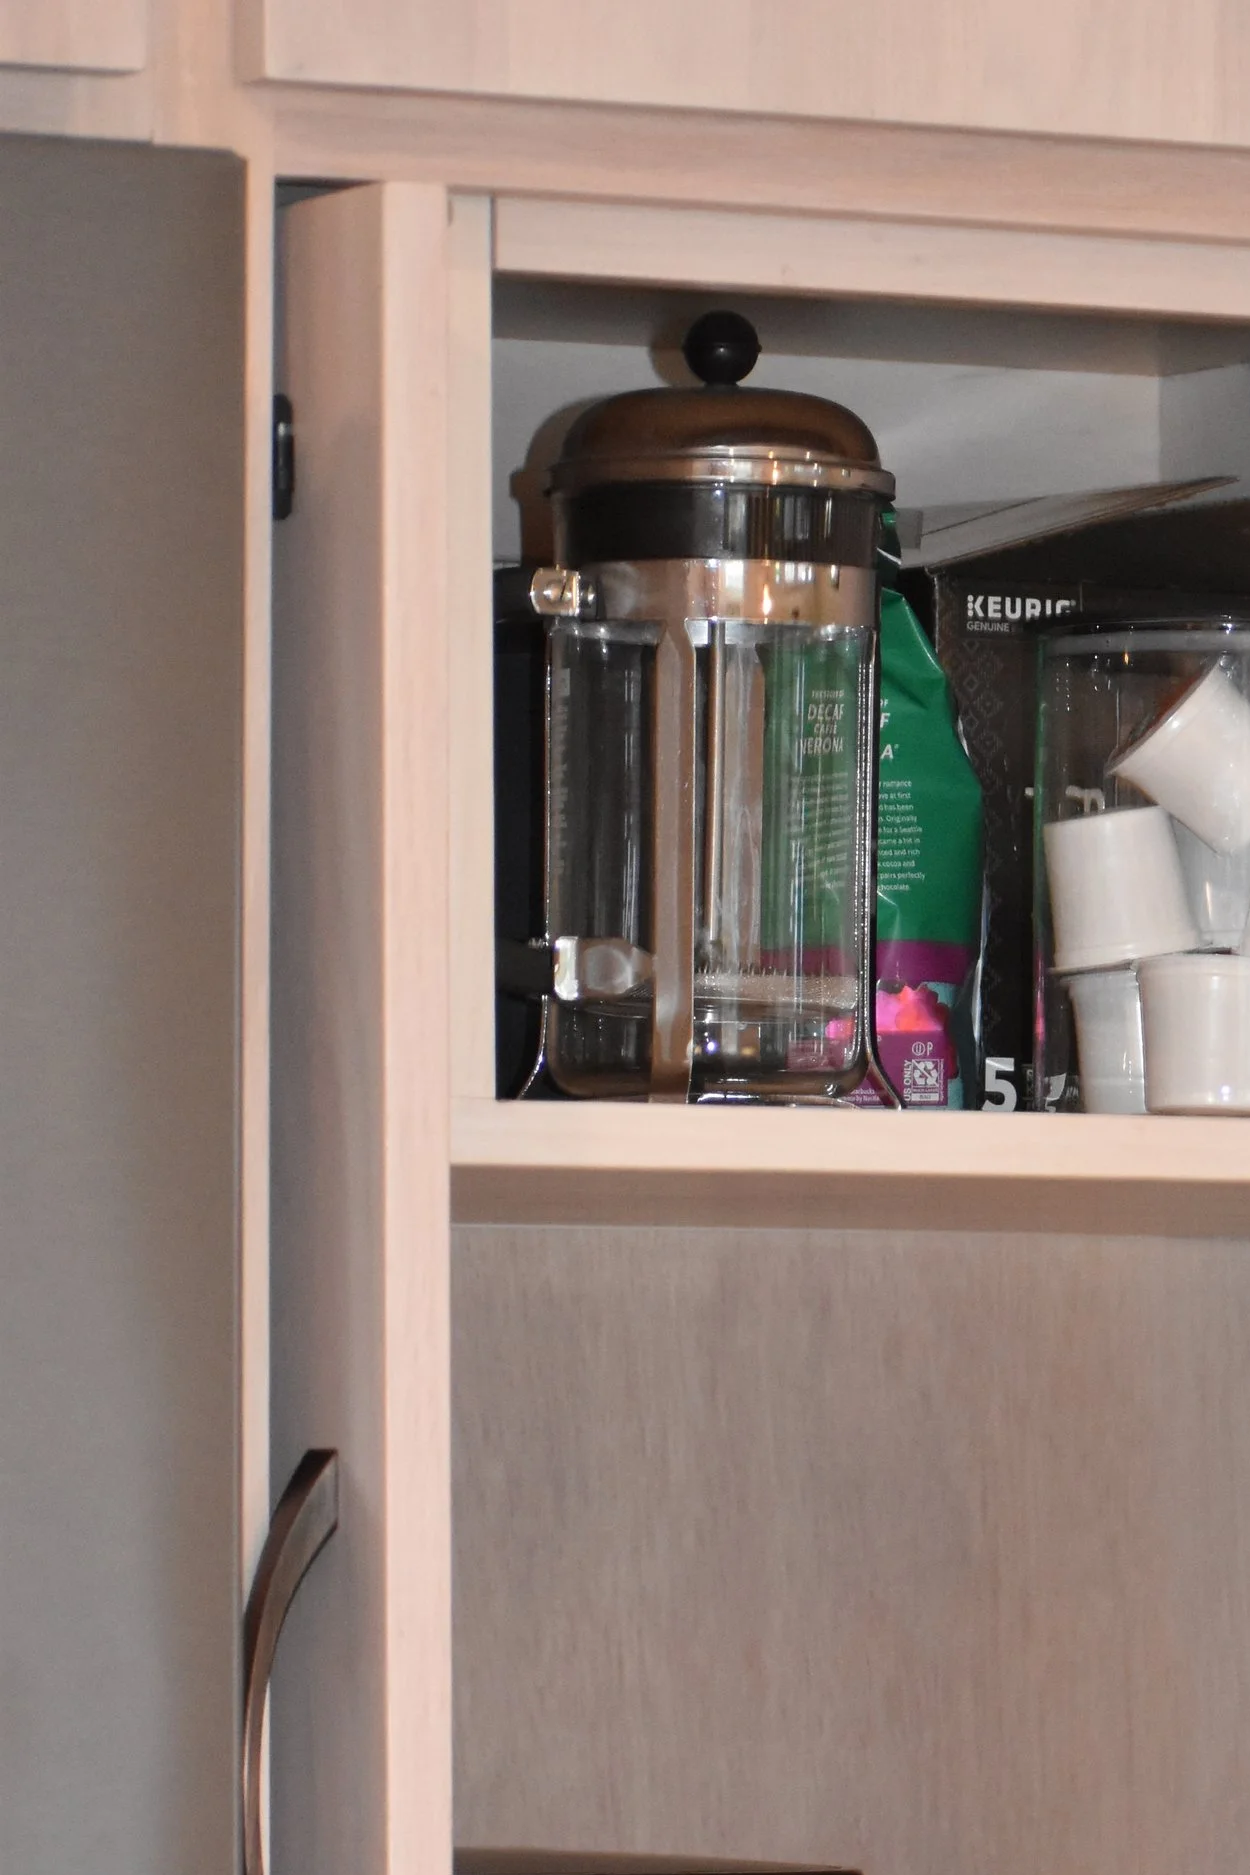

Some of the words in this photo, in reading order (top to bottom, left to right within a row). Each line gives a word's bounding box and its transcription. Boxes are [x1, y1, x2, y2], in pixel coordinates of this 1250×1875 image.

[966, 621, 1010, 632] GENUINE
[807, 703, 845, 721] DECAF
[903, 1059, 912, 1086] ONLY
[903, 1088, 912, 1101] US
